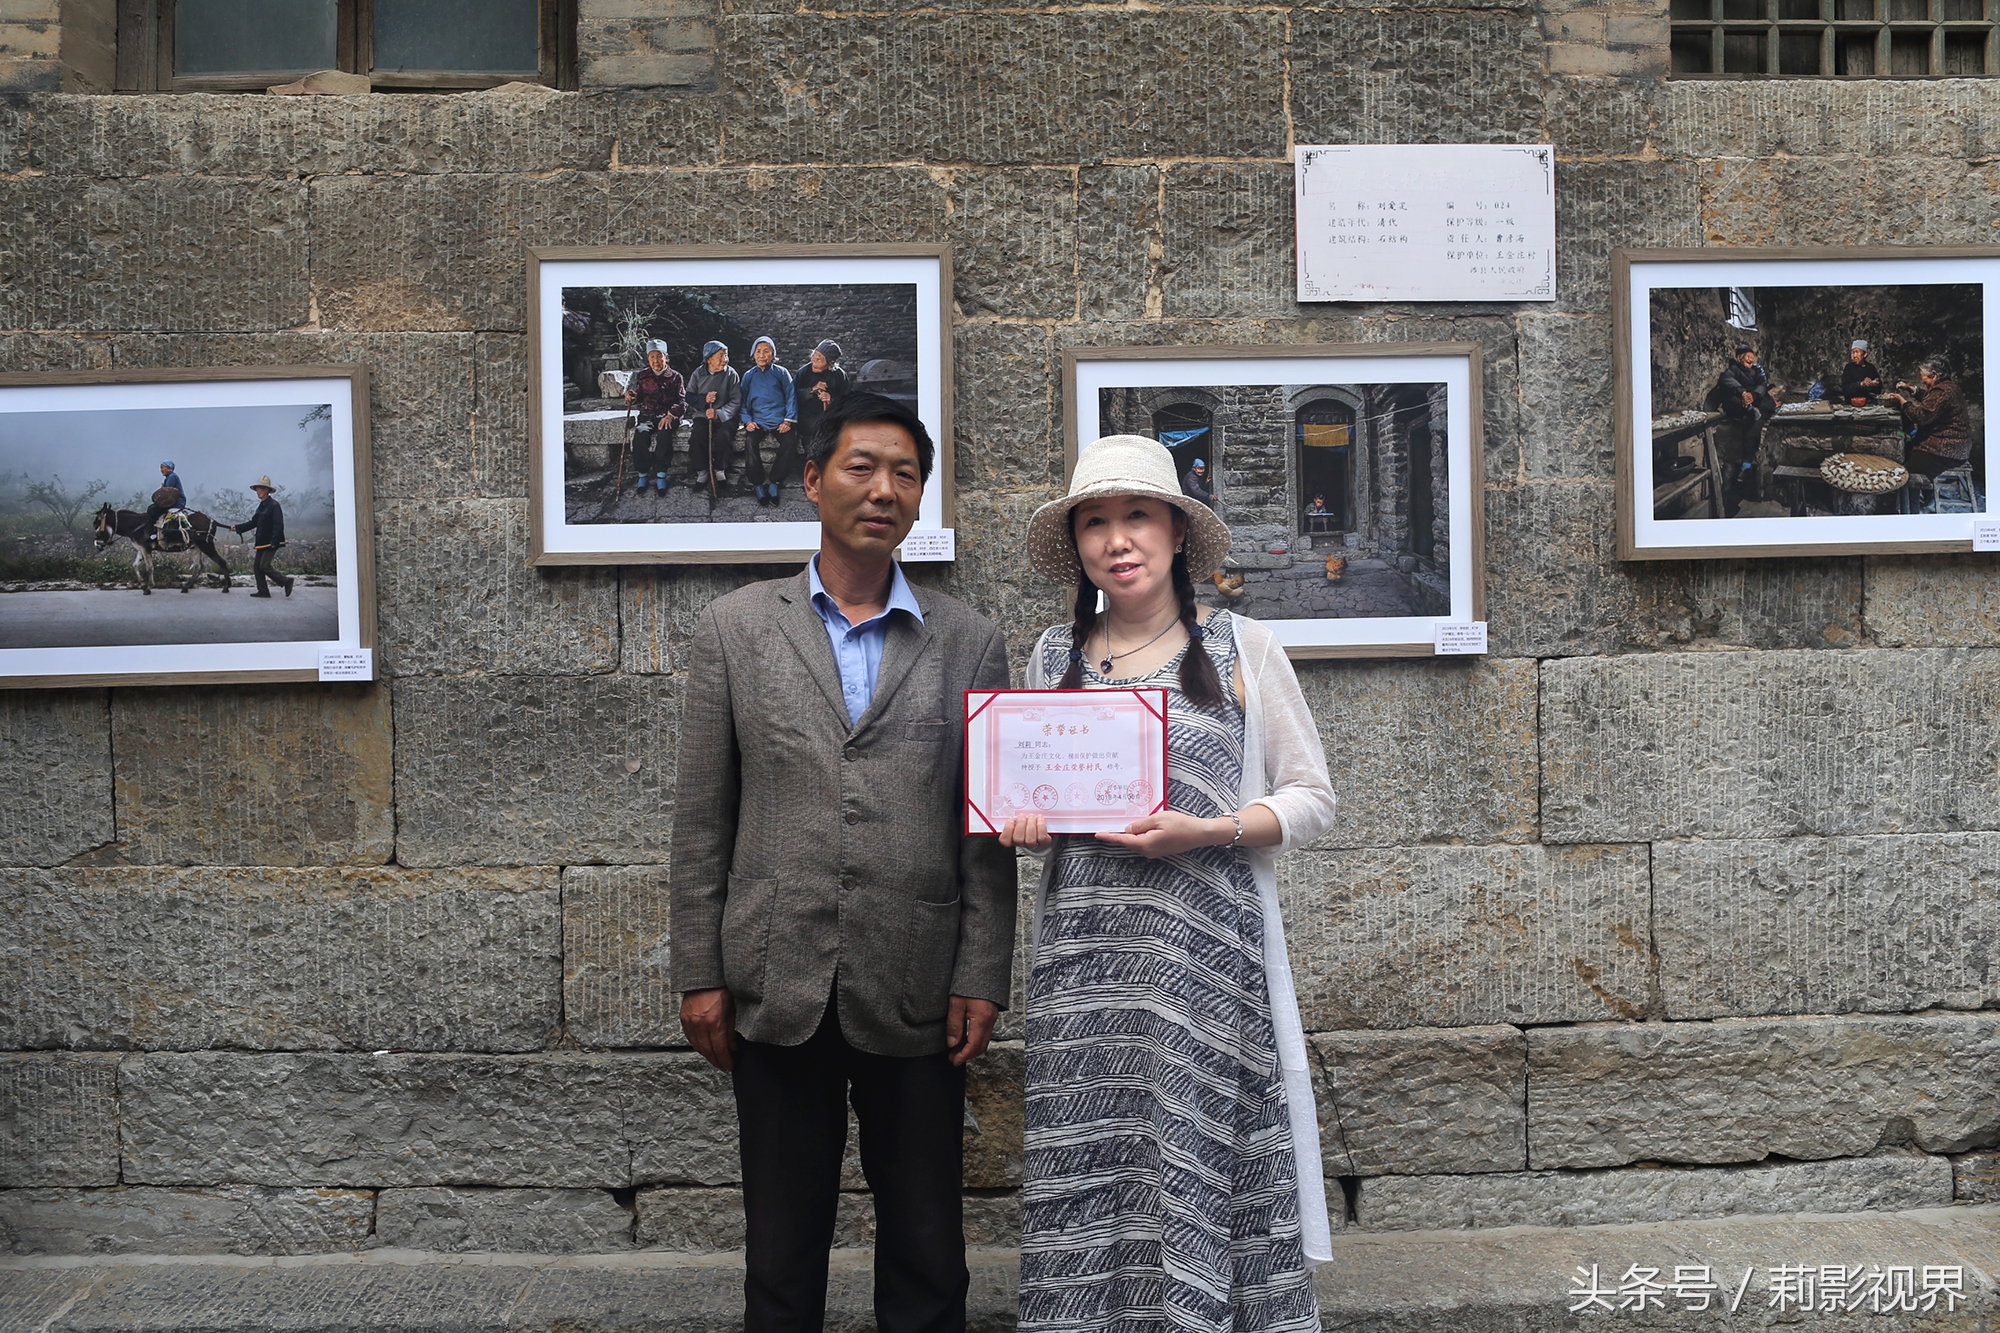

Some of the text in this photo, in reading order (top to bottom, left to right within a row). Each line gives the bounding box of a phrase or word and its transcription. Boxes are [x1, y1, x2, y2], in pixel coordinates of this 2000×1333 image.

[1042, 723, 1090, 736] 荣誉证书
[1045, 762, 1102, 772] 王金庄荣誉村民
